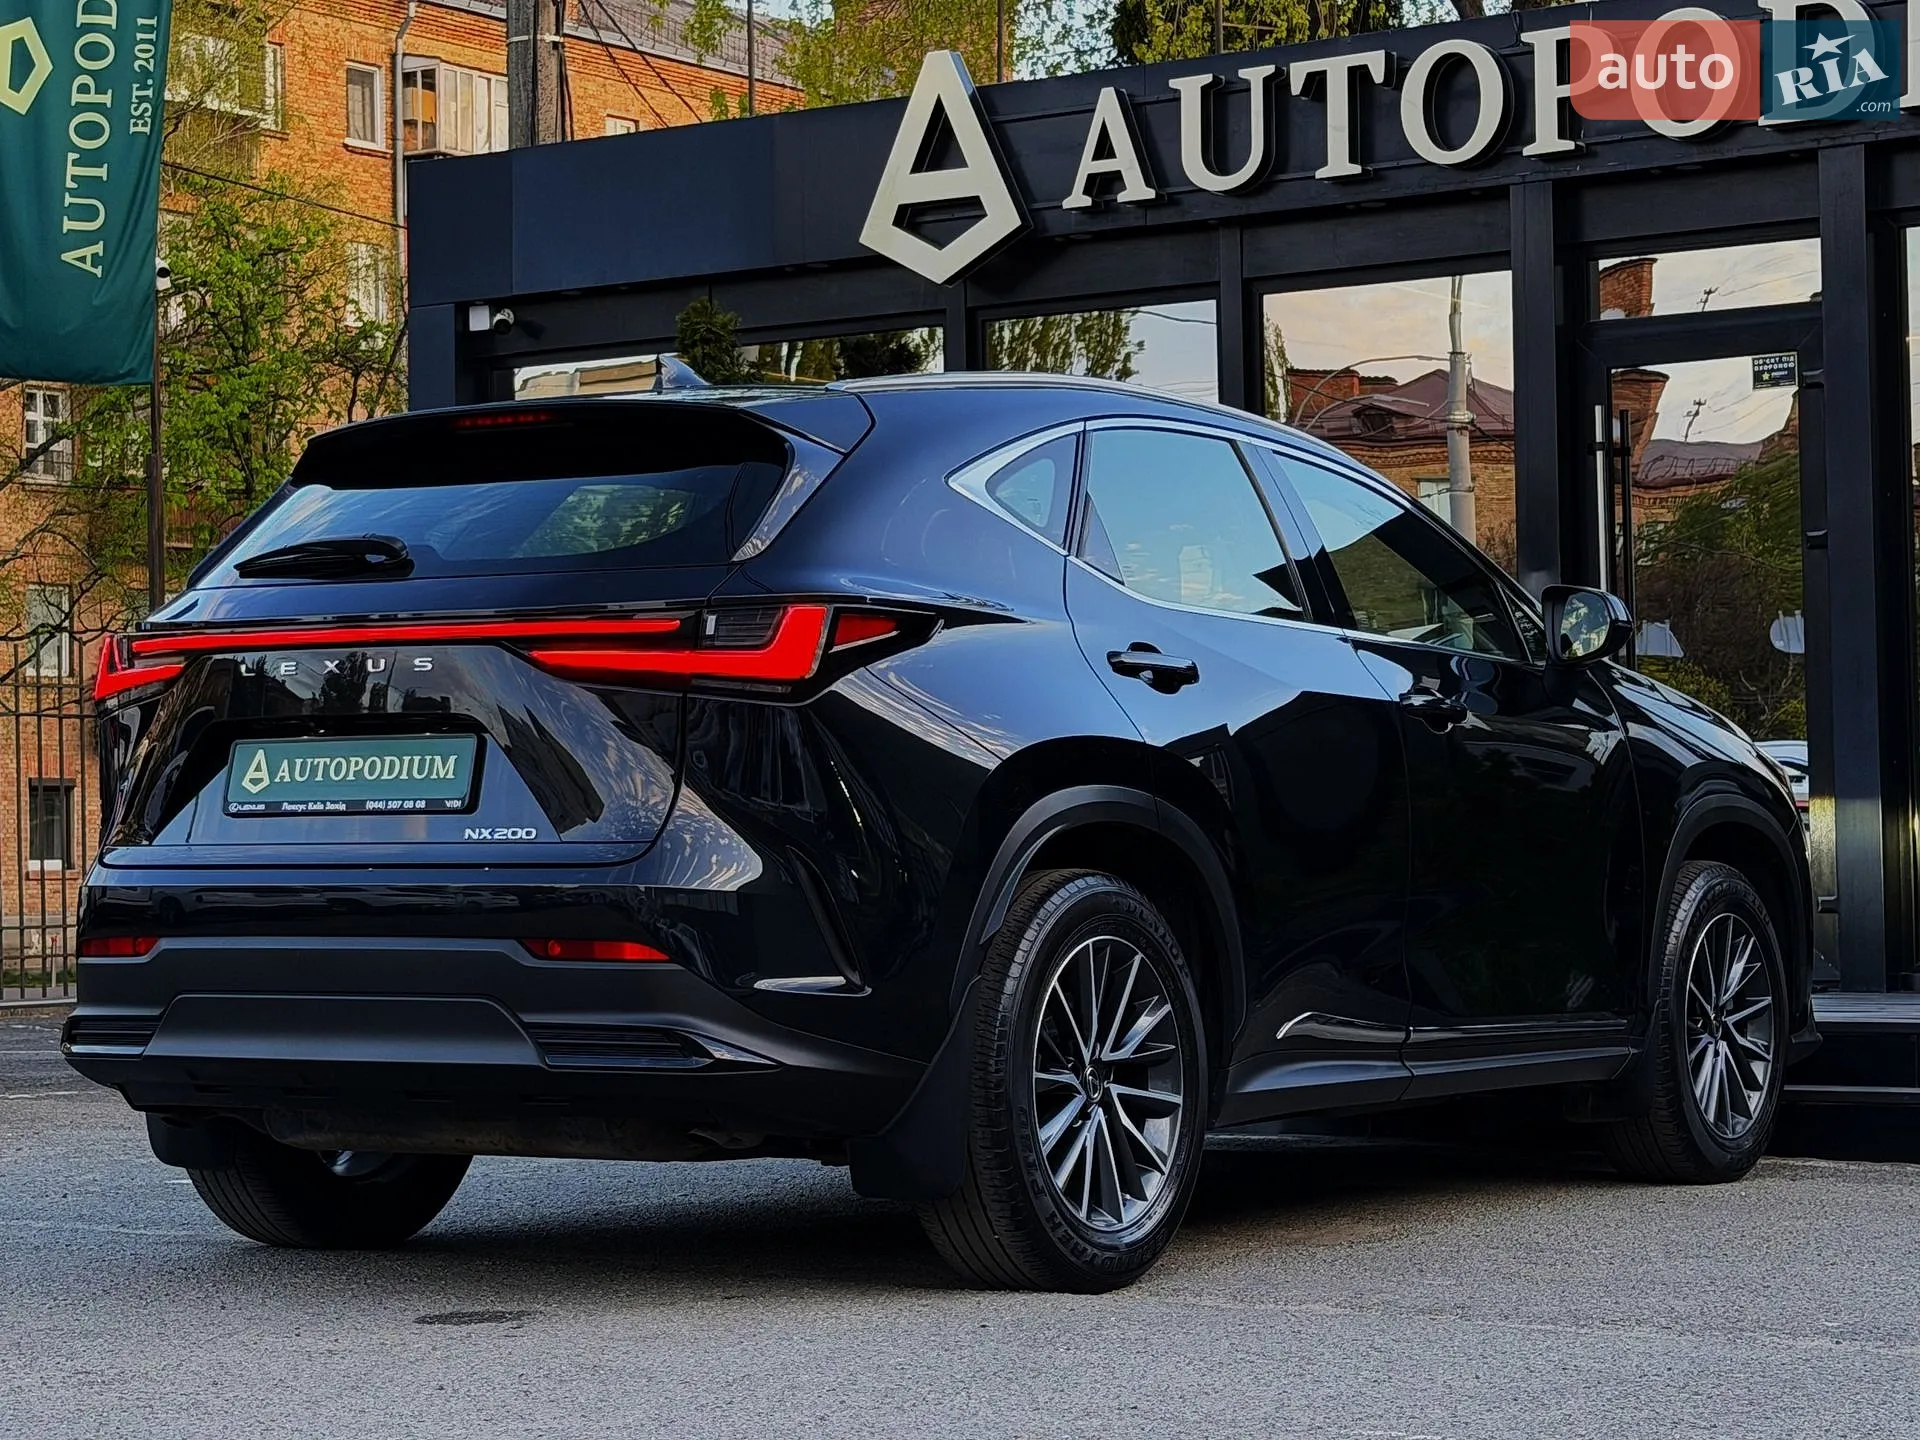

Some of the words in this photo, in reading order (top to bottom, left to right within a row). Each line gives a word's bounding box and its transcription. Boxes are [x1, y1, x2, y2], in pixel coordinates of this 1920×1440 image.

[134, 16, 158, 73] 2011
[129, 79, 153, 136] EST.
[240, 657, 434, 677] LEXUS
[274, 755, 458, 783] AUTOPODIUM
[366, 800, 386, 810] (044)
[387, 801, 401, 809] 507
[464, 828, 537, 840] NX200
